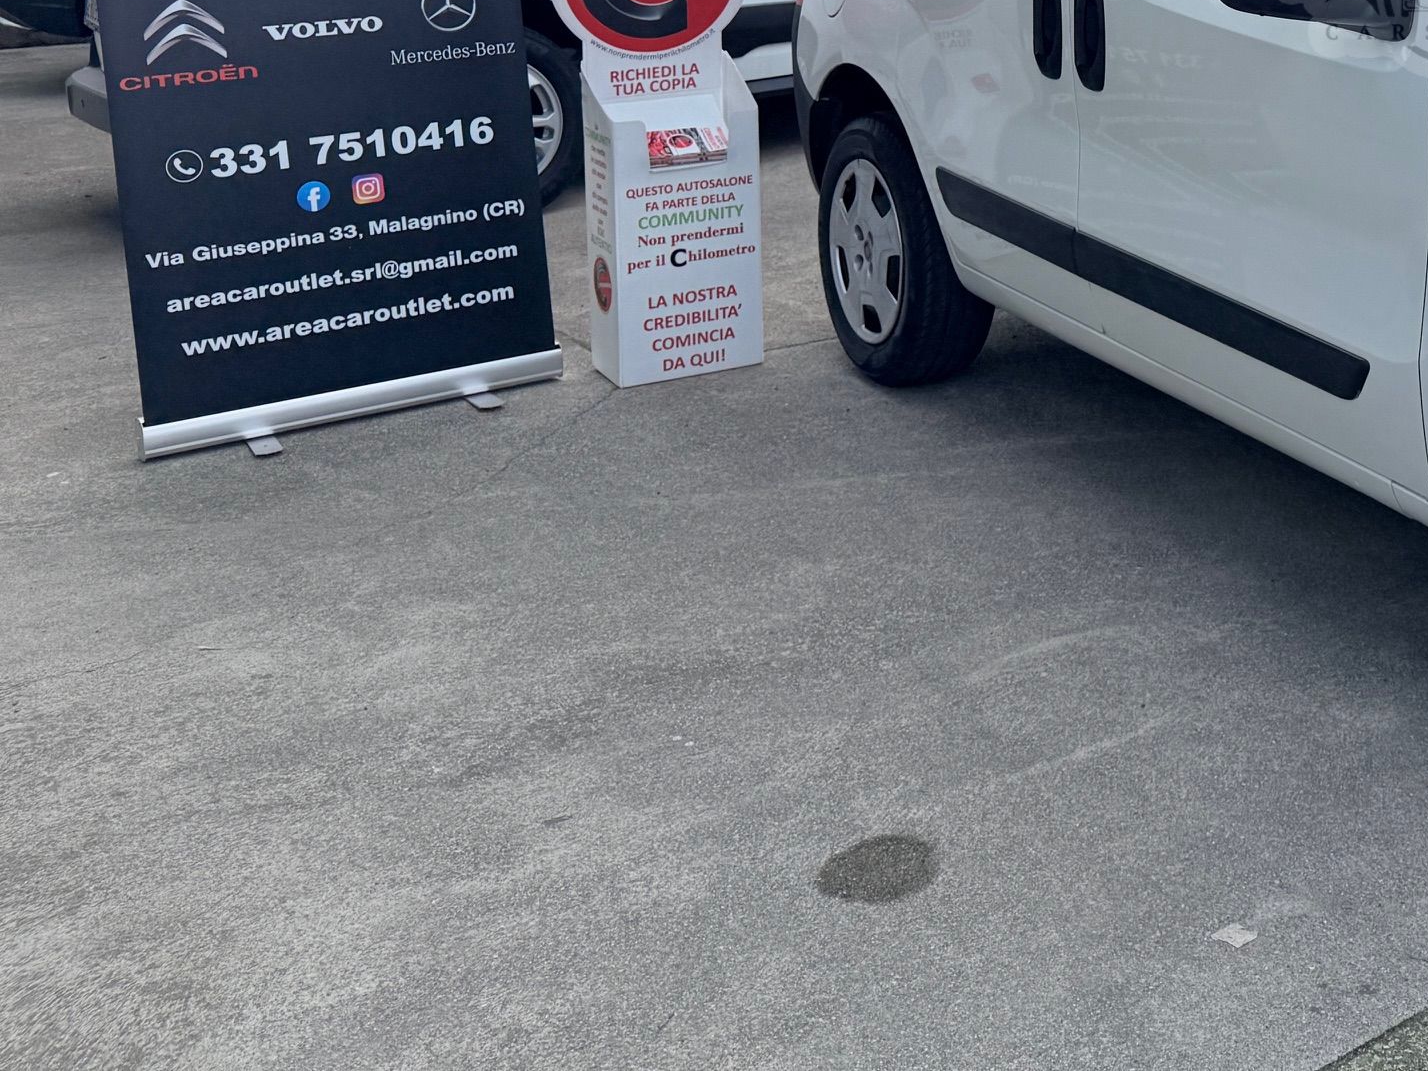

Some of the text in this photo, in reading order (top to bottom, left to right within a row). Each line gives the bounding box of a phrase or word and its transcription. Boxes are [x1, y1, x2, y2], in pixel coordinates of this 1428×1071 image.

[262, 15, 383, 41] VOLVO
[390, 40, 516, 66] Mercedes-Benz
[119, 63, 259, 92] CITROËN
[610, 62, 700, 83] RICHIEDI LA
[613, 76, 697, 97] TUA COPIA
[209, 115, 495, 178] 331 7510416
[625, 174, 753, 199] QUESTO AUTOSALONE
[645, 192, 736, 212] FA PARTE DELLA
[638, 204, 745, 230] COMMUNITY
[145, 198, 526, 269] Via Giuseppina 33, Malagnino (CR)
[638, 223, 745, 248] Non prendermi
[627, 244, 756, 274] per il Chilometro
[166, 242, 519, 314] areacaroutlet.srl@gmail.com
[648, 284, 738, 309] LA NOSTRA
[181, 283, 515, 357] www.areacaroutlet.com
[652, 326, 736, 352] COMINCIA
[663, 348, 726, 372] DA QUI!
